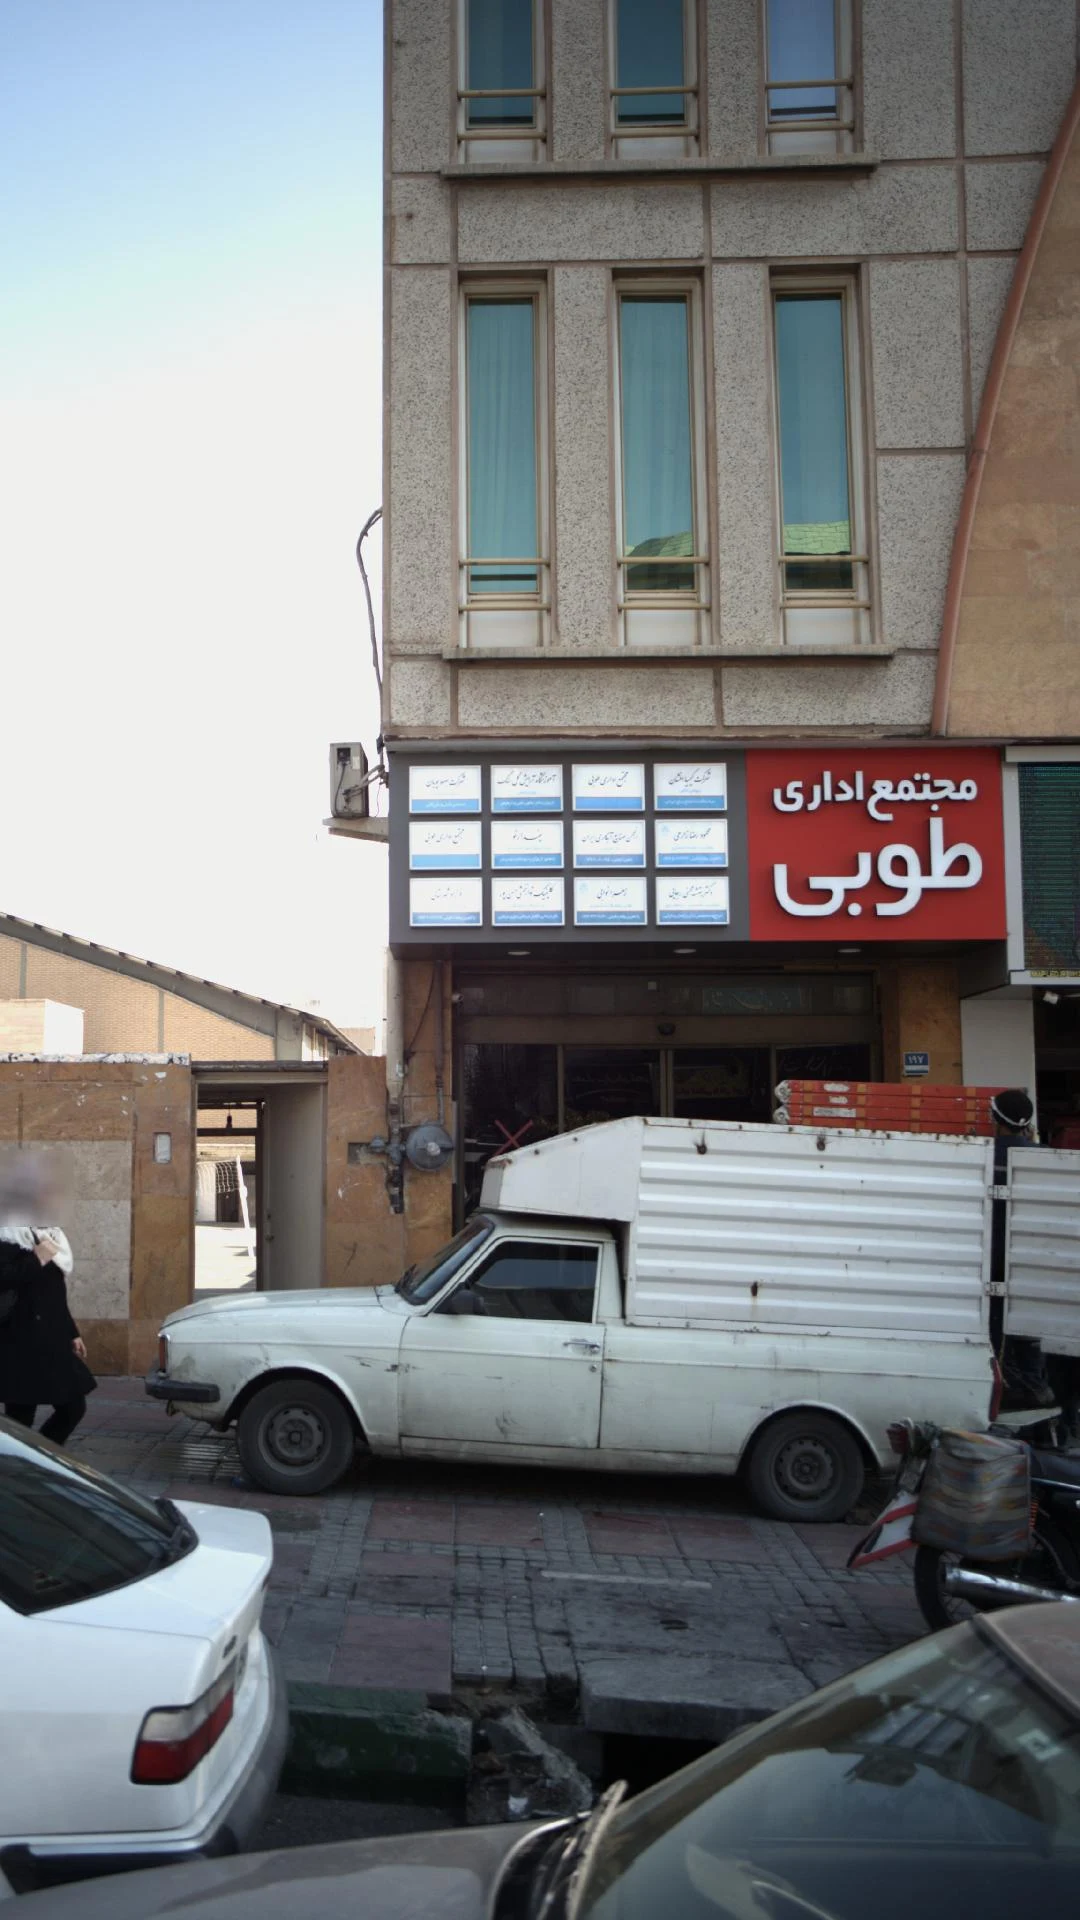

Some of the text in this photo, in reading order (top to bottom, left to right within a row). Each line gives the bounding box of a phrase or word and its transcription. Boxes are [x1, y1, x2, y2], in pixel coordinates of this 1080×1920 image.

[773, 770, 978, 822] مجتمع اداری
[773, 816, 983, 917] طوبی
